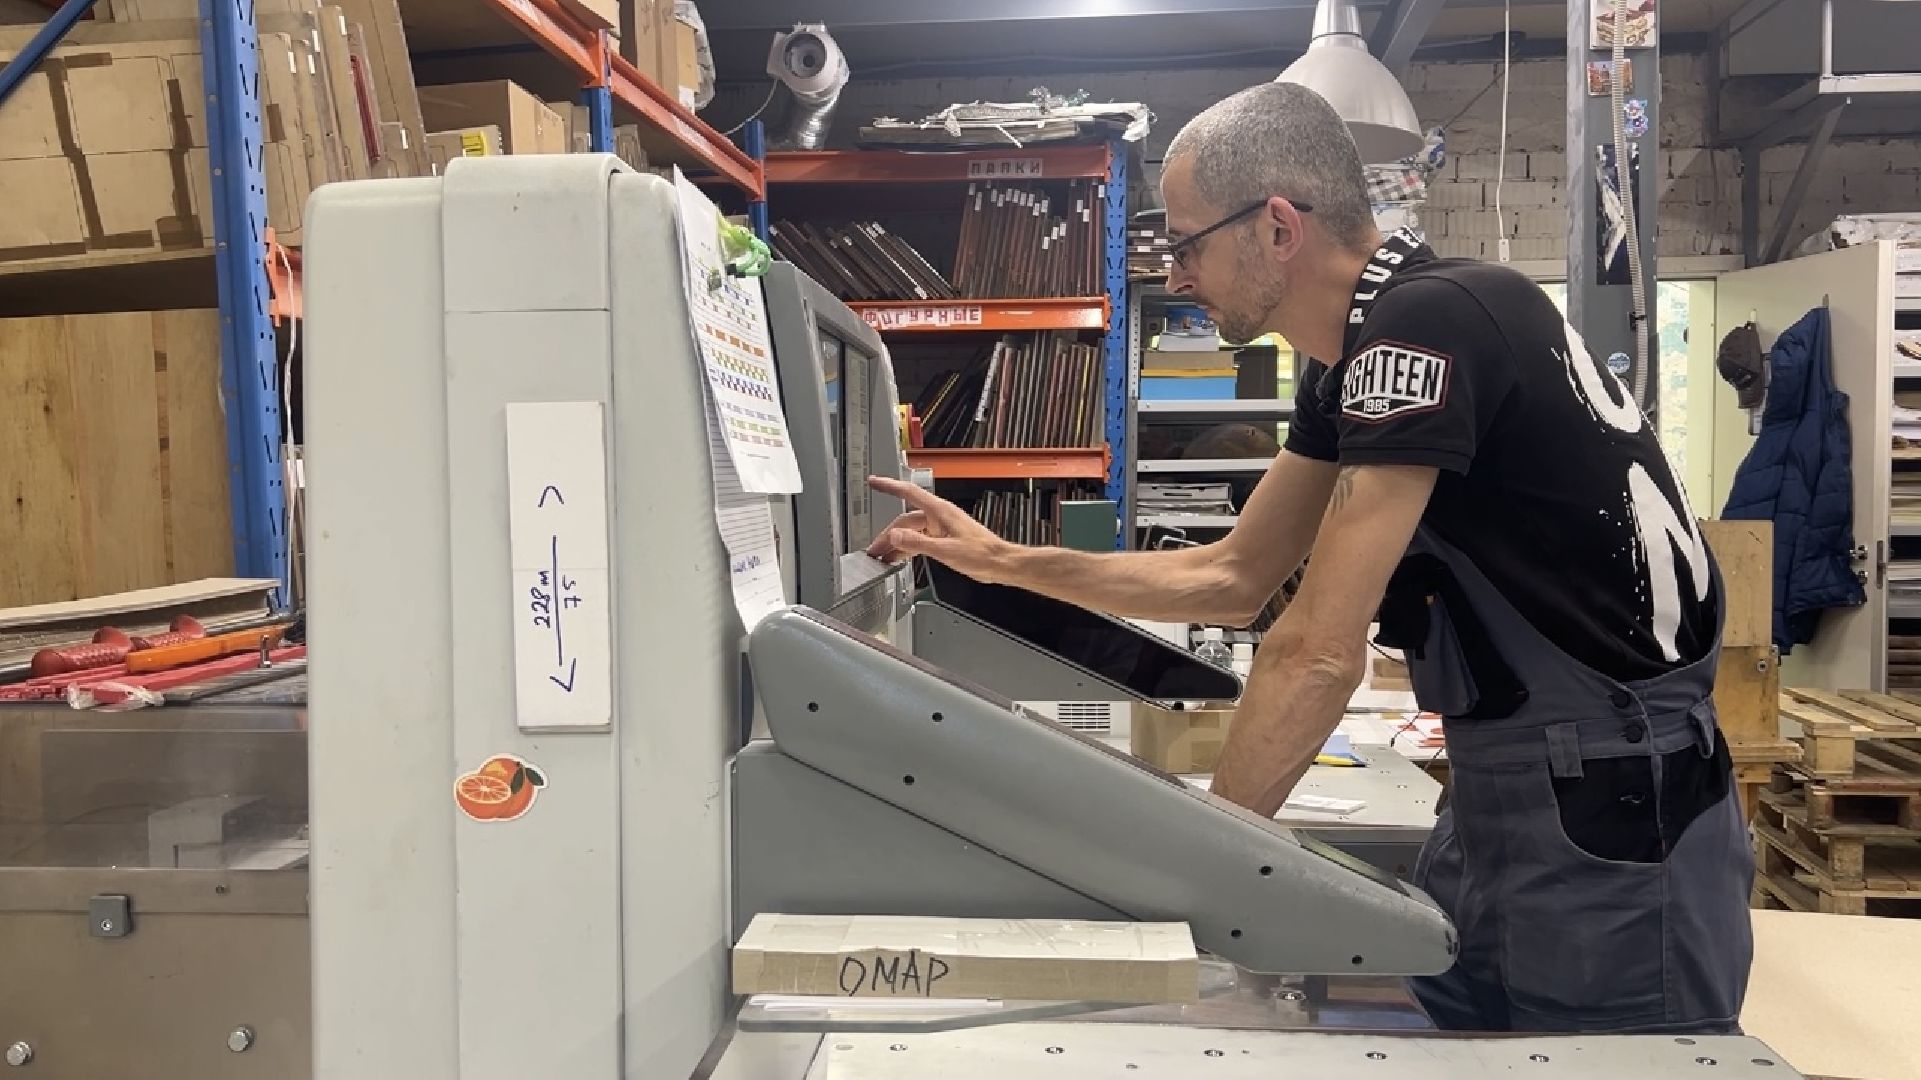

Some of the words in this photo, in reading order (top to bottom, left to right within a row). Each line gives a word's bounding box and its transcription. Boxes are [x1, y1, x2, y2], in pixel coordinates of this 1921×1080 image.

[971, 161, 1040, 174] ПАПКИ
[1349, 247, 1404, 324] PLUS
[864, 307, 980, 325] ФИГУРНЫЕ
[1363, 398, 1390, 413] 1985
